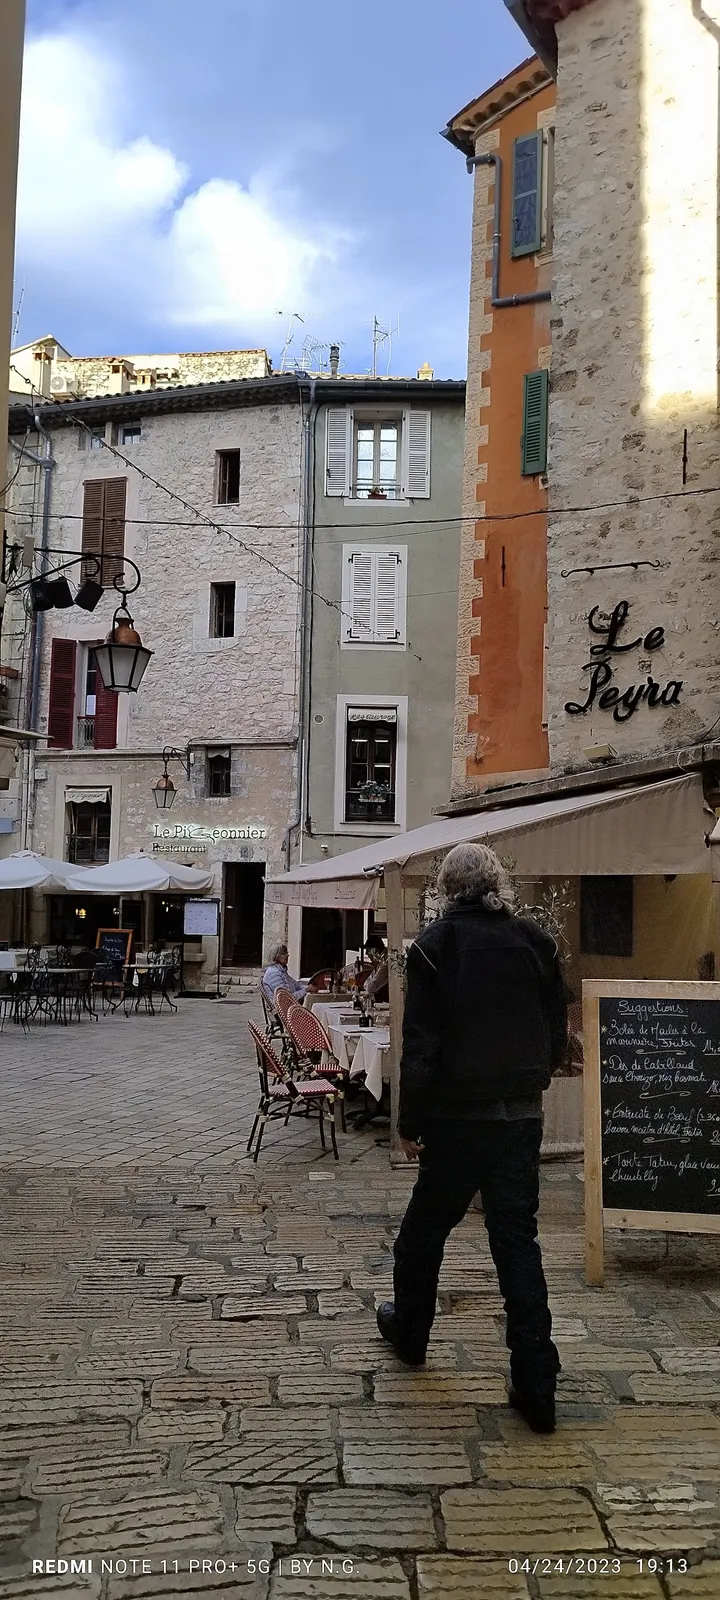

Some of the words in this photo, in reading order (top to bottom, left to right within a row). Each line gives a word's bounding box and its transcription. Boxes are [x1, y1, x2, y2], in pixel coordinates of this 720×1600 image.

[588, 600, 665, 656] Le
[564, 656, 683, 722] Peyra
[154, 824, 170, 838] Le
[152, 842, 207, 853] Restaurant
[640, 1024, 648, 1035] de
[690, 1021, 706, 1035] la
[654, 1108, 664, 1119] de
[610, 1150, 641, 1168] Tarte
